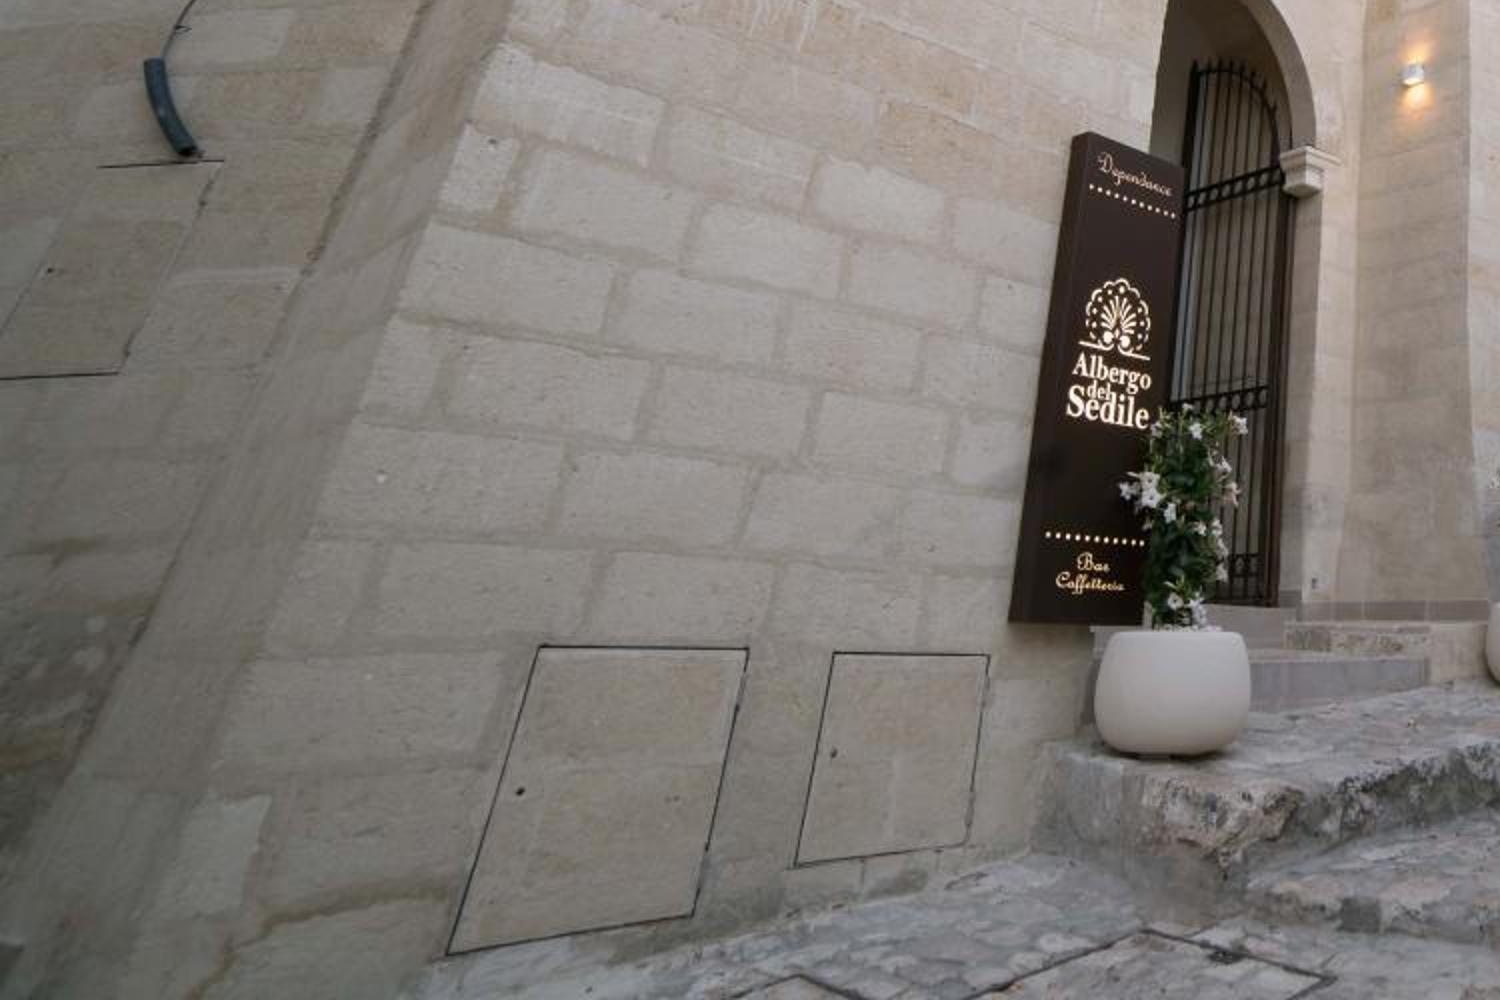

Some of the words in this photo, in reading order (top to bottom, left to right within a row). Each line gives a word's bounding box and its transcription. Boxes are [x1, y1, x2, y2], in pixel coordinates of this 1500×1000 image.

[1072, 351, 1151, 394] Albergo
[1087, 380, 1111, 400] del
[1066, 384, 1150, 429] Sedile
[1077, 552, 1110, 572] Bar
